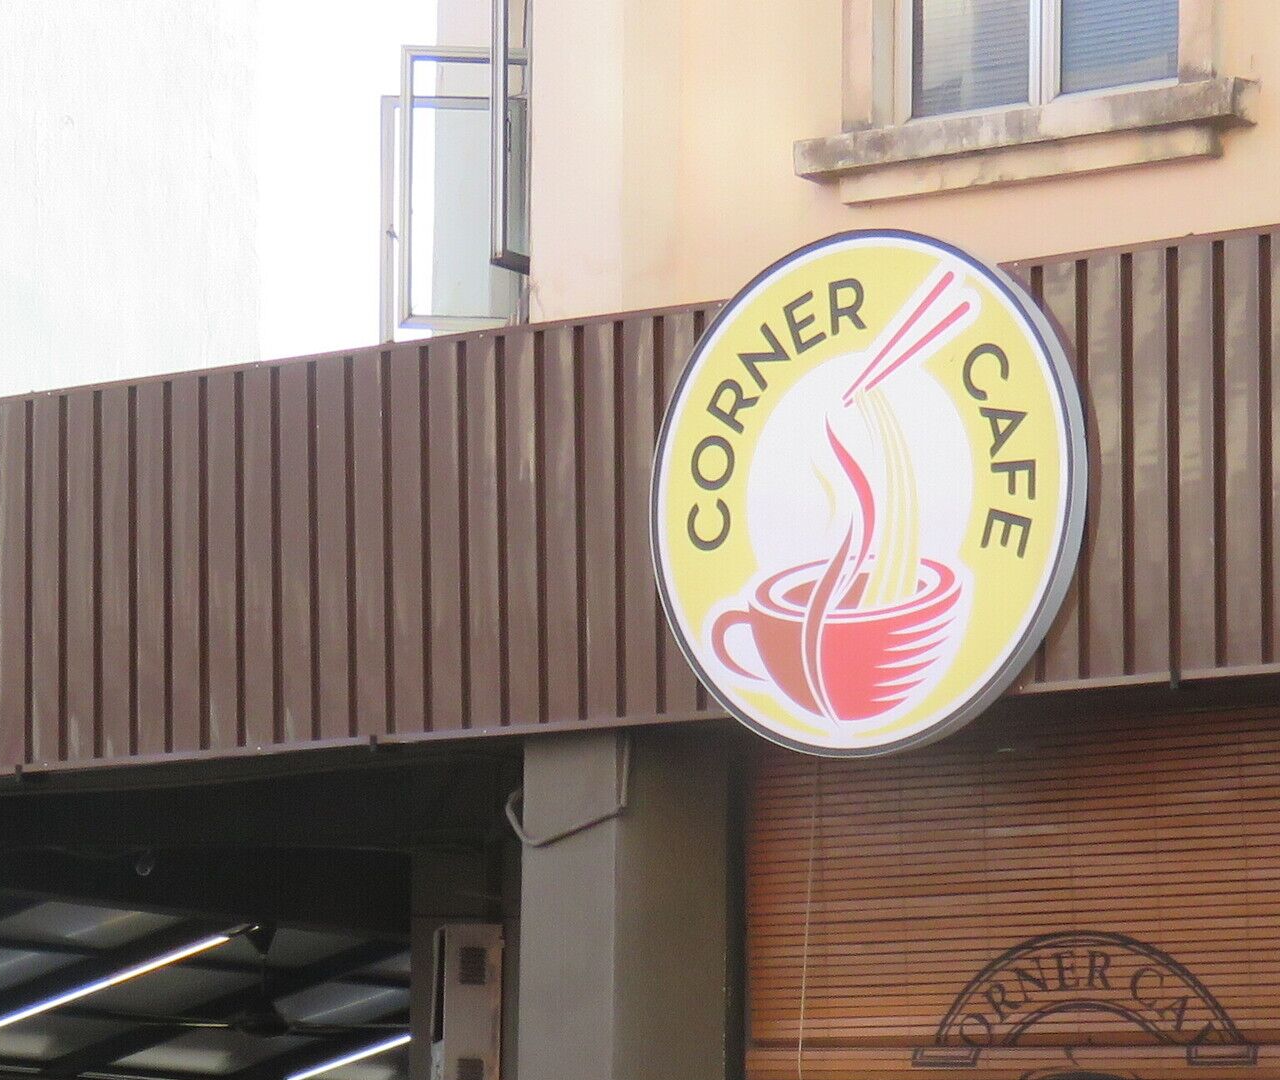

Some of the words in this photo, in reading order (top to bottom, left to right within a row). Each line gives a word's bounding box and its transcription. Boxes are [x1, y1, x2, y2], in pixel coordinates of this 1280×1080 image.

[687, 278, 867, 552] CORNER
[961, 342, 1038, 559] CAFE
[957, 948, 1112, 1046] ORNER
